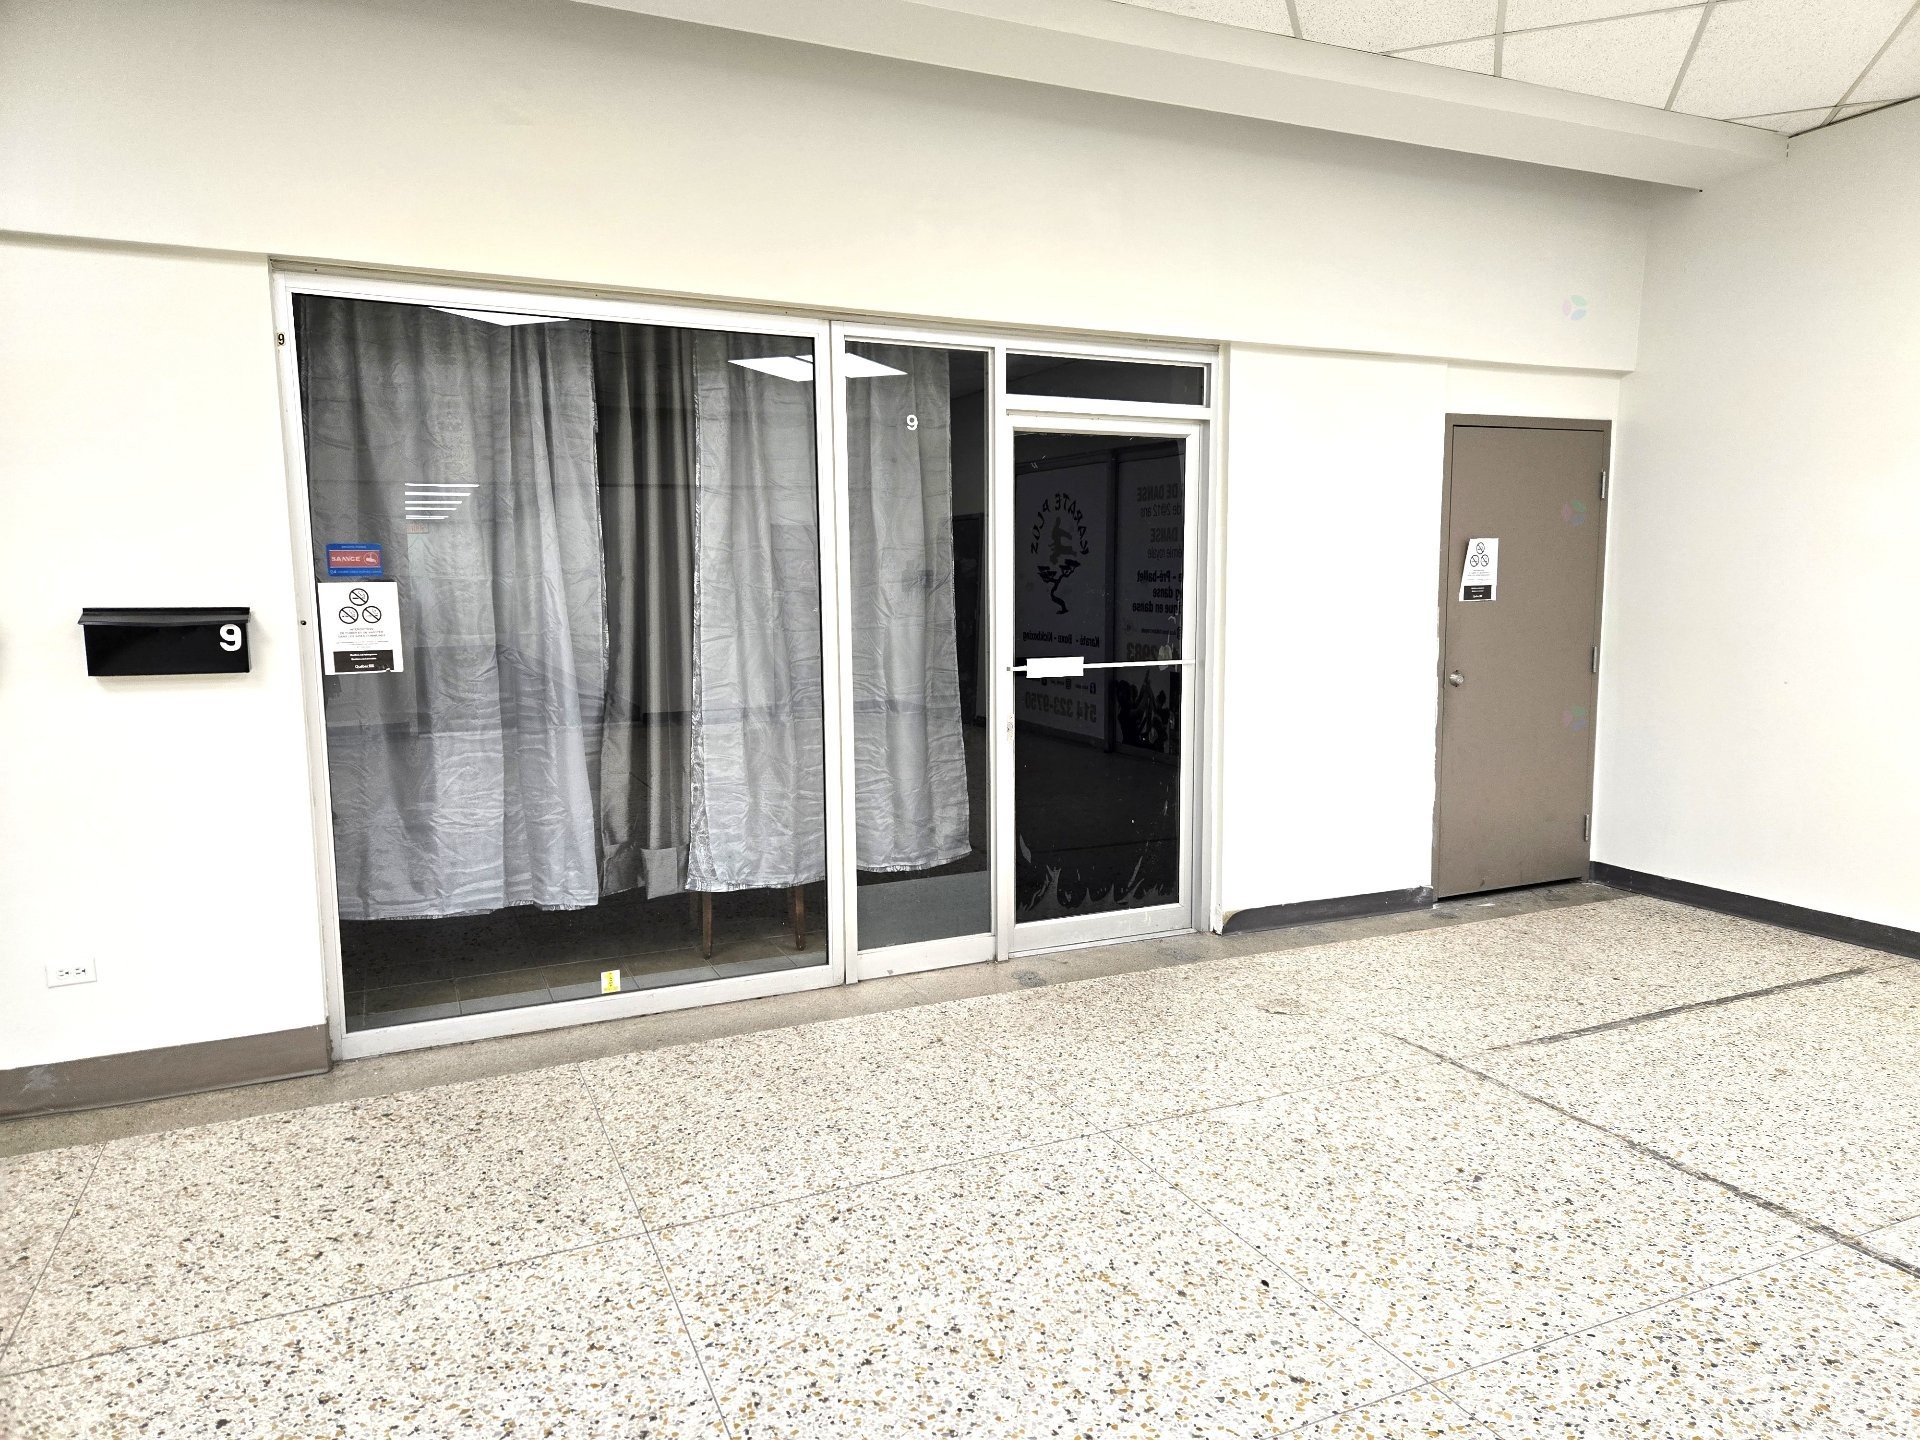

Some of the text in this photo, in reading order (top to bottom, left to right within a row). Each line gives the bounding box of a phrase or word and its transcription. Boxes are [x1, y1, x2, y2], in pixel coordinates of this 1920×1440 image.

[278, 333, 285, 345] 9
[906, 414, 919, 431] 9
[219, 623, 242, 652] 9
